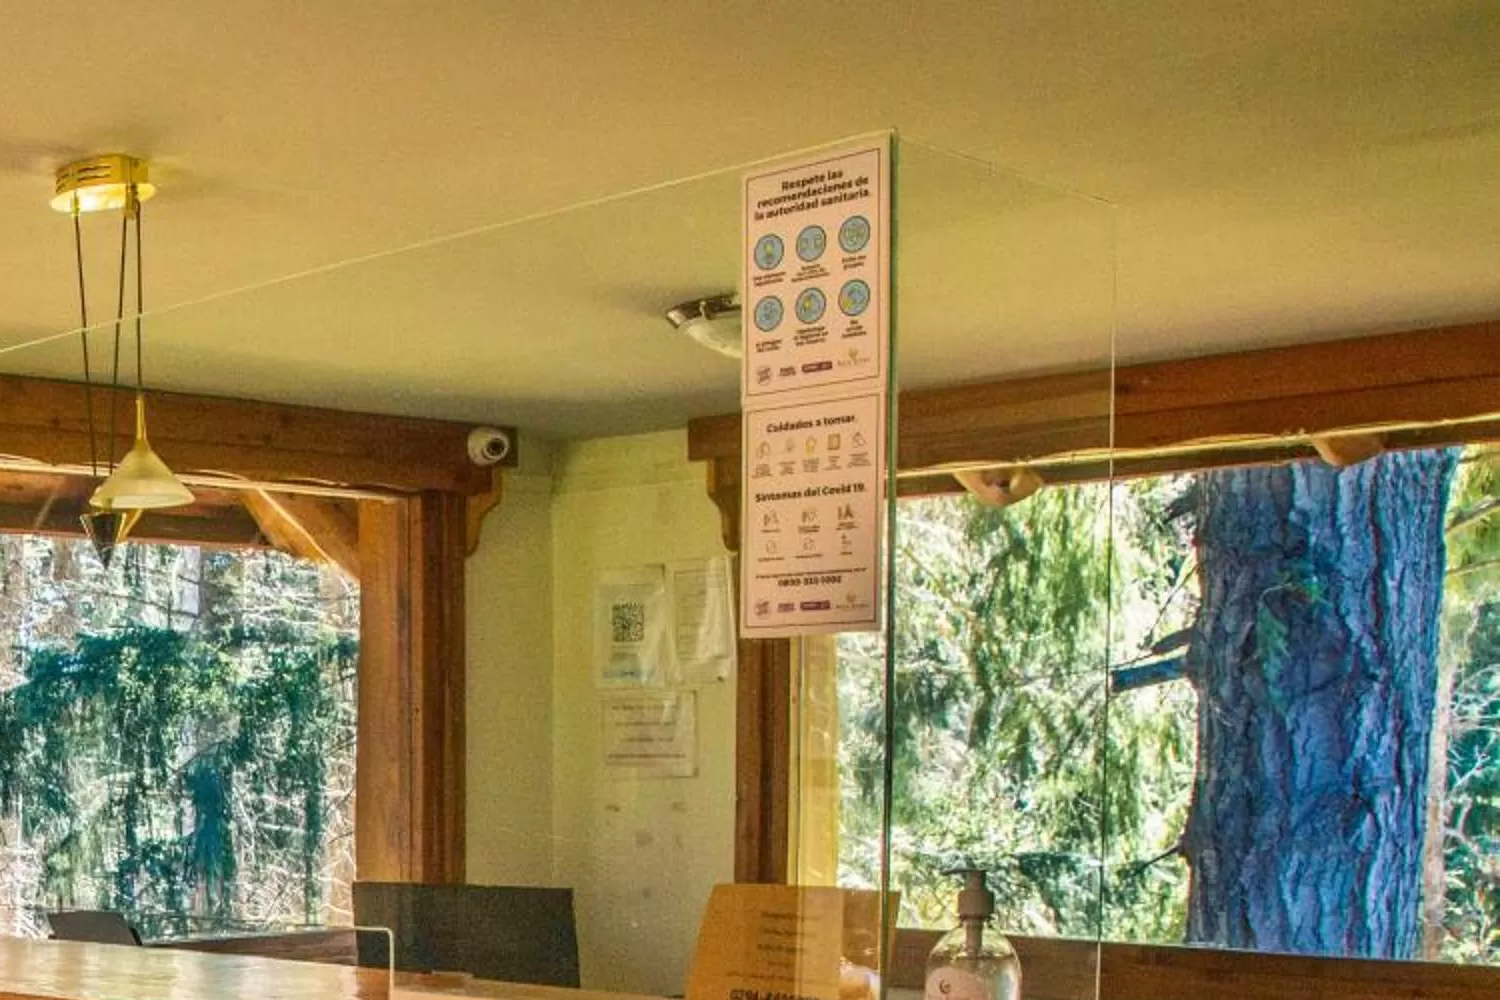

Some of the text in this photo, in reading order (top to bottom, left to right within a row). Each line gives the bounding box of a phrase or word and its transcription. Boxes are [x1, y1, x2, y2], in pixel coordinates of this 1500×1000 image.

[782, 169, 843, 191] Respete las
[757, 176, 869, 208] recomendaciones de
[754, 188, 869, 221] la autoridad sanitaria
[766, 420, 813, 433] Cuidados
[815, 419, 821, 427] a
[804, 486, 820, 497] del
[822, 484, 851, 496] Covid
